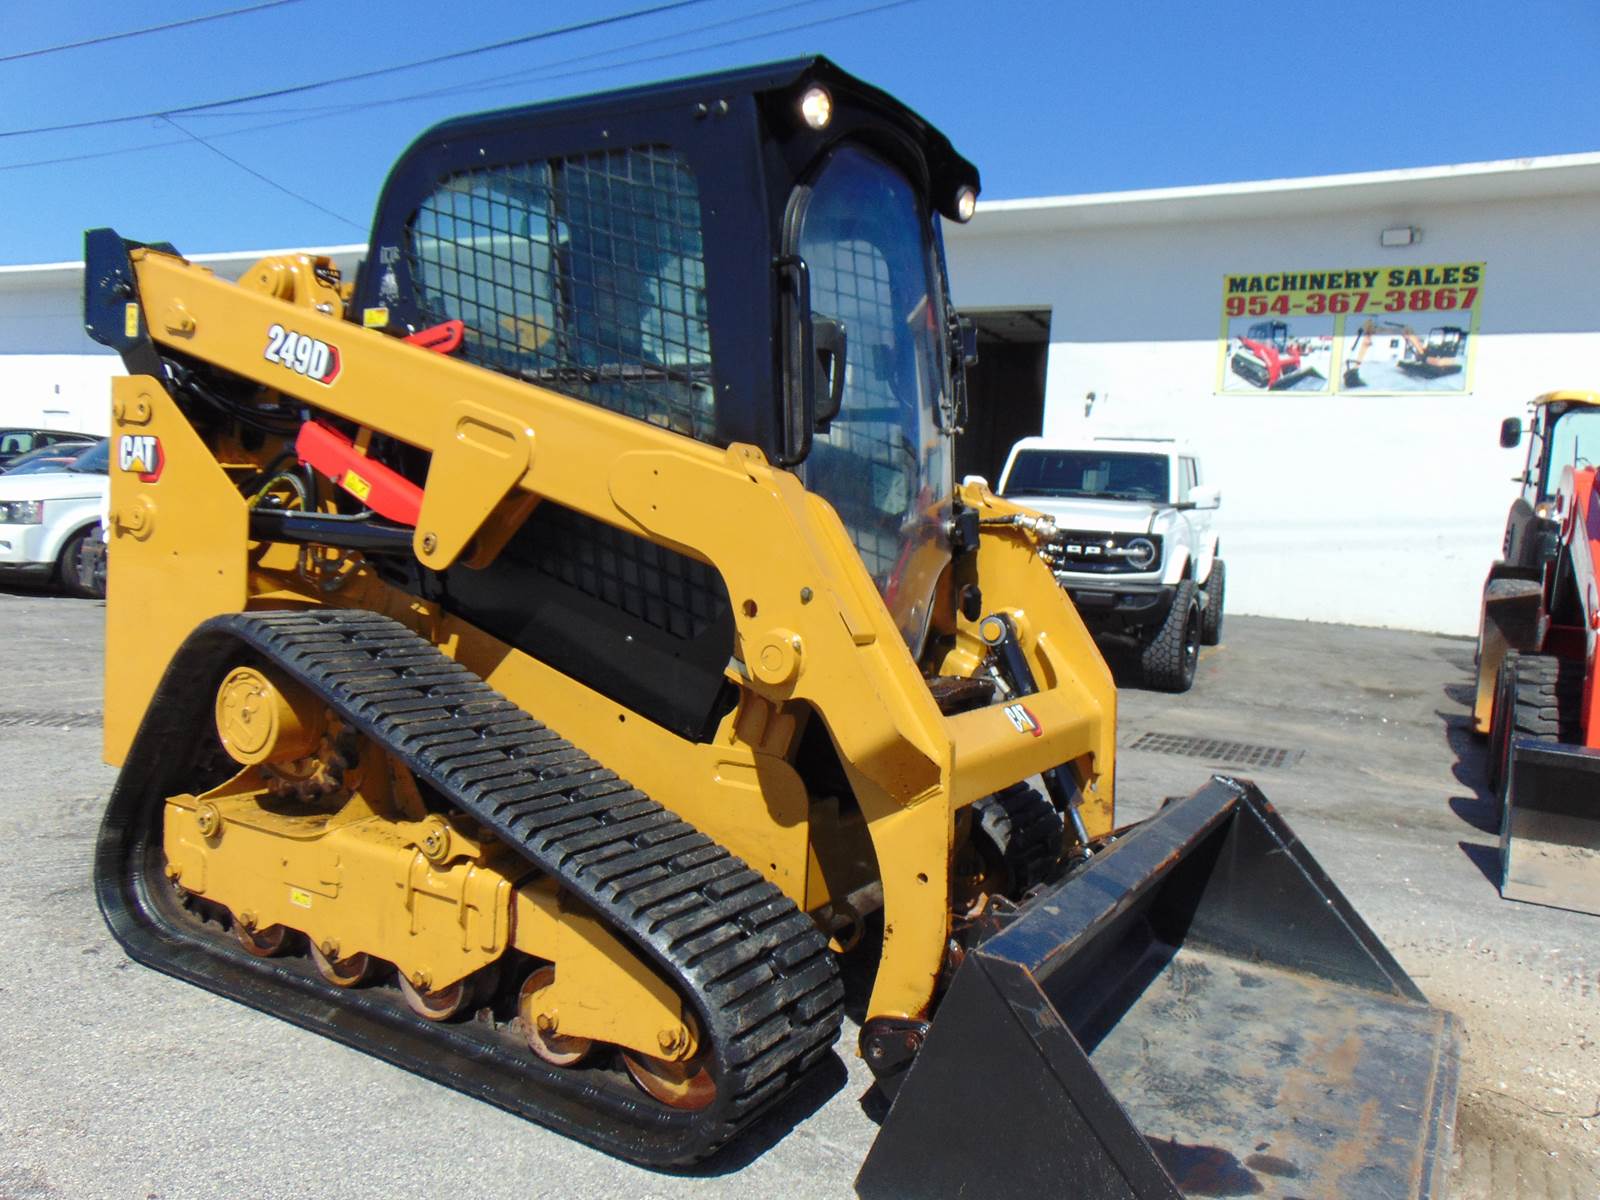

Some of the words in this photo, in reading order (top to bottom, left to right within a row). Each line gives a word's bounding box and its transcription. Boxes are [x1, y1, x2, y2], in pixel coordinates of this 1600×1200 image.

[1228, 271, 1379, 293] MACHINERY
[1388, 266, 1480, 288] SALES
[1225, 288, 1478, 316] 954-367-3867
[264, 324, 329, 380] 249D
[119, 435, 156, 473] CAT
[1003, 704, 1037, 733] CAT
